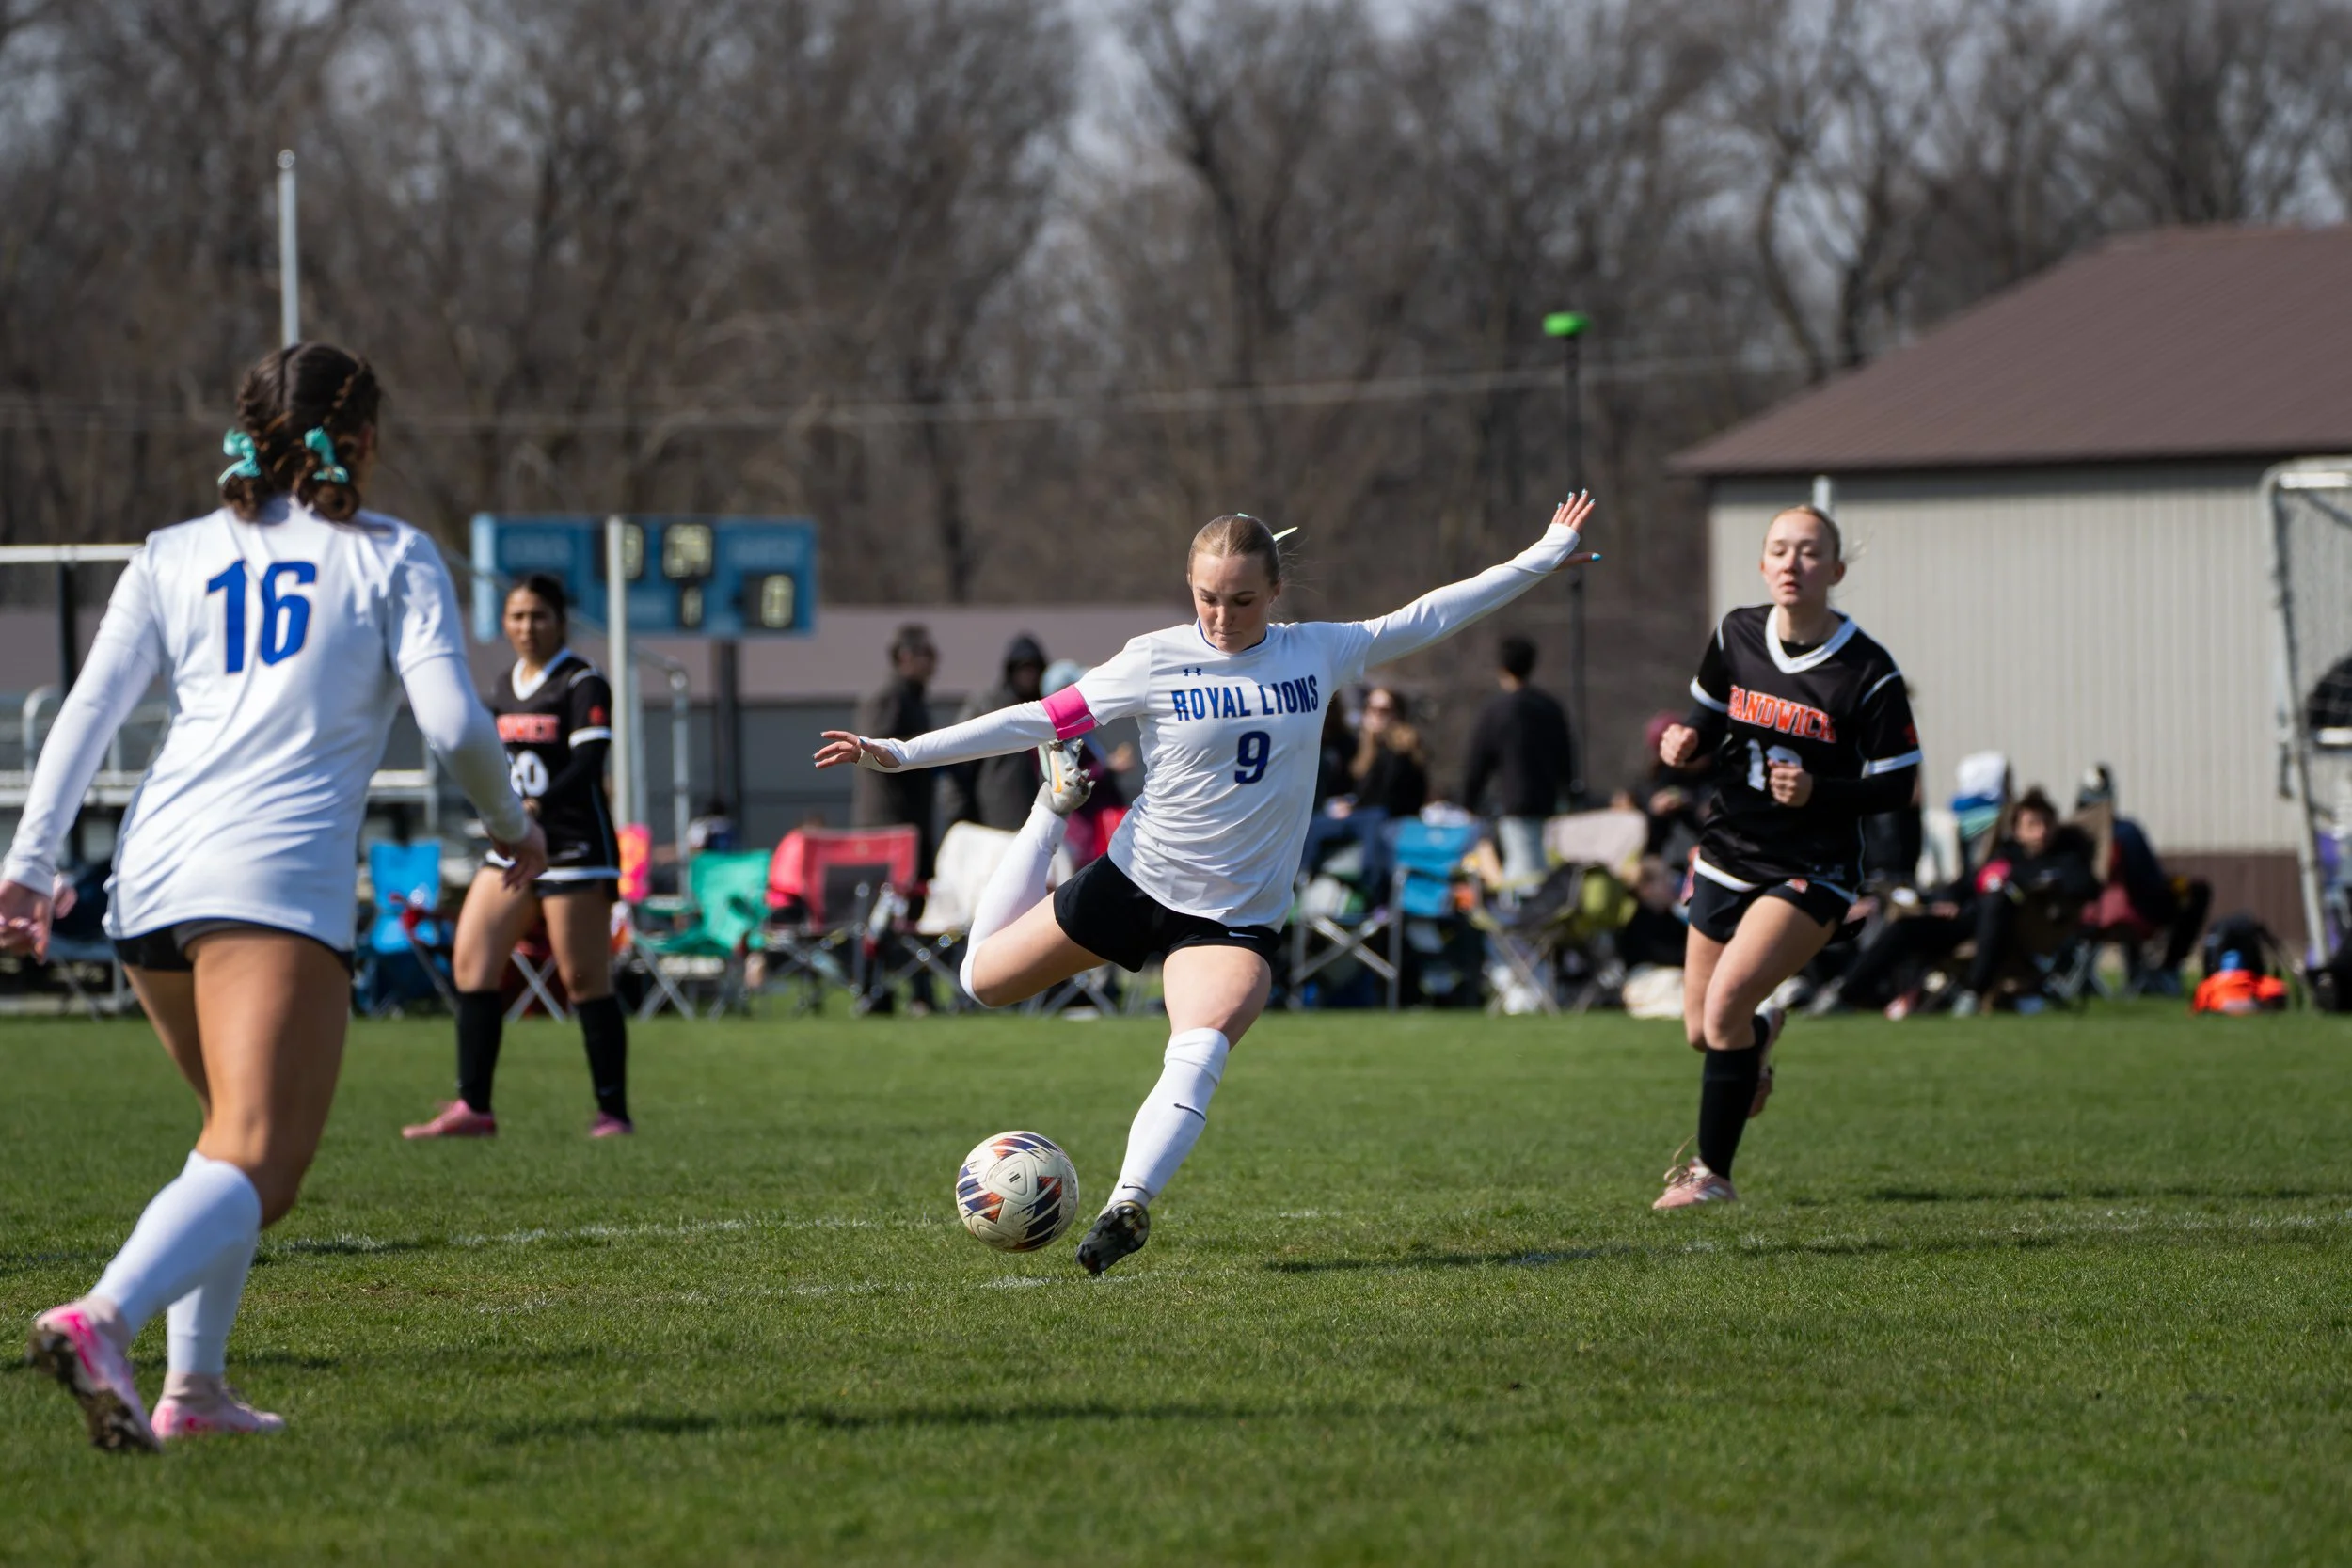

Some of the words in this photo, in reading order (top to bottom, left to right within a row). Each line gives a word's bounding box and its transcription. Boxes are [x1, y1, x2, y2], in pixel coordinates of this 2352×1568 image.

[207, 558, 317, 674] 16
[1171, 686, 1251, 721] ROYAL
[1258, 674, 1318, 716] LIONS
[1727, 684, 1837, 743] SANDWICH
[1234, 731, 1270, 784] 9
